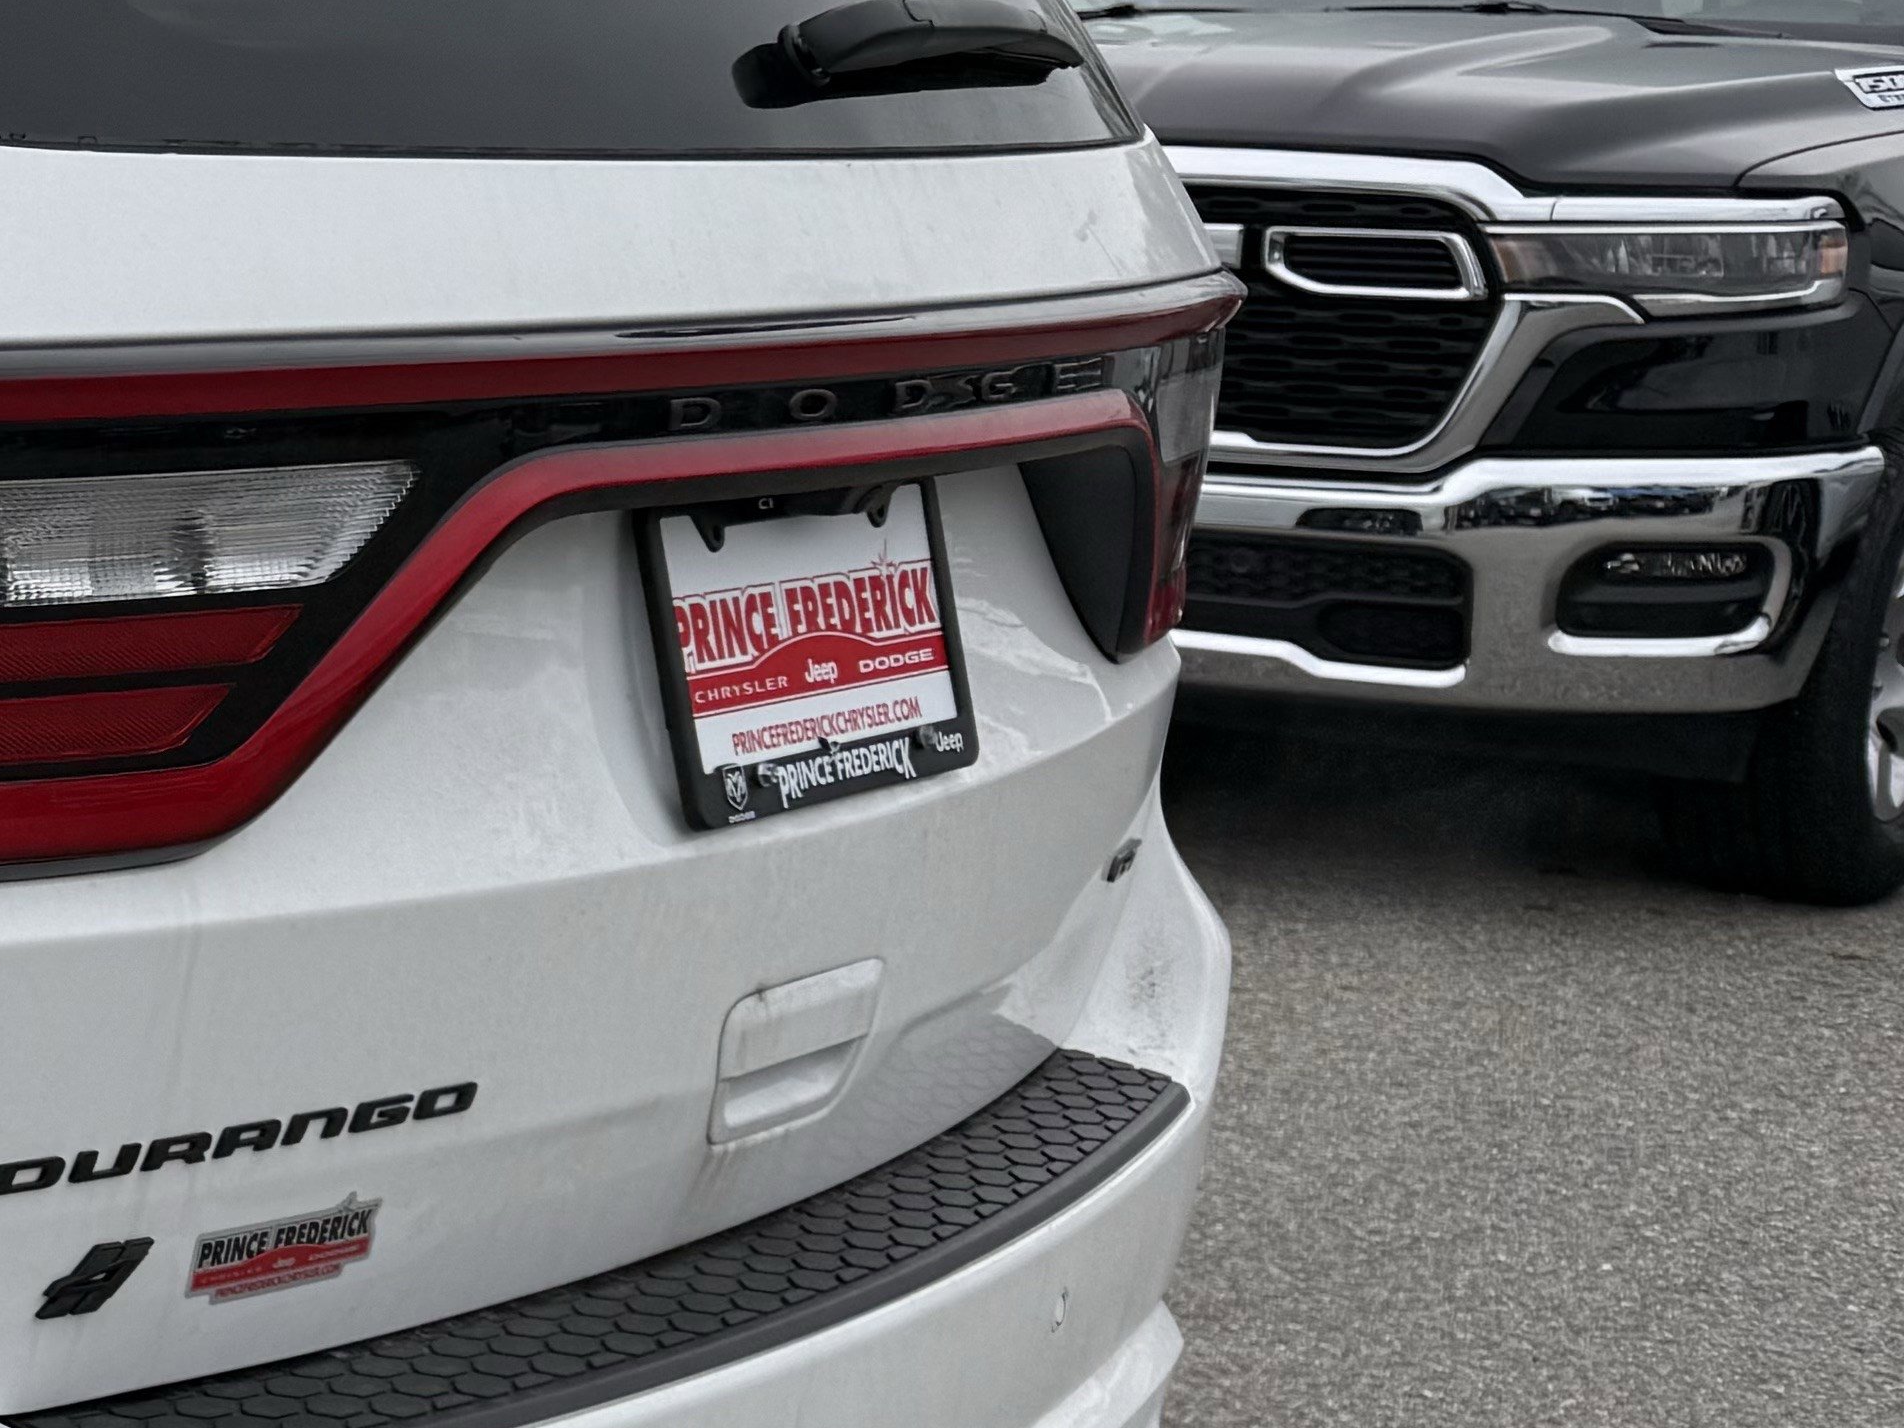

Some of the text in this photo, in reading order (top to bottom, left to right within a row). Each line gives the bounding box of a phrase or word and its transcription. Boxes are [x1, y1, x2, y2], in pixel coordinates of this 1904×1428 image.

[668, 356, 1104, 432] DODGE
[672, 566, 938, 664] PRINCE FREDERICK
[694, 648, 935, 704] CHRYSLER Jeep DODGE
[732, 696, 922, 756] PRINCEFREDERICKCHRYSLER.COM
[935, 731, 965, 753] Jeep
[776, 736, 917, 809] PRINCE FREDERICK
[197, 1229, 270, 1269] PRINCE
[273, 1208, 373, 1248] FREDERICK
